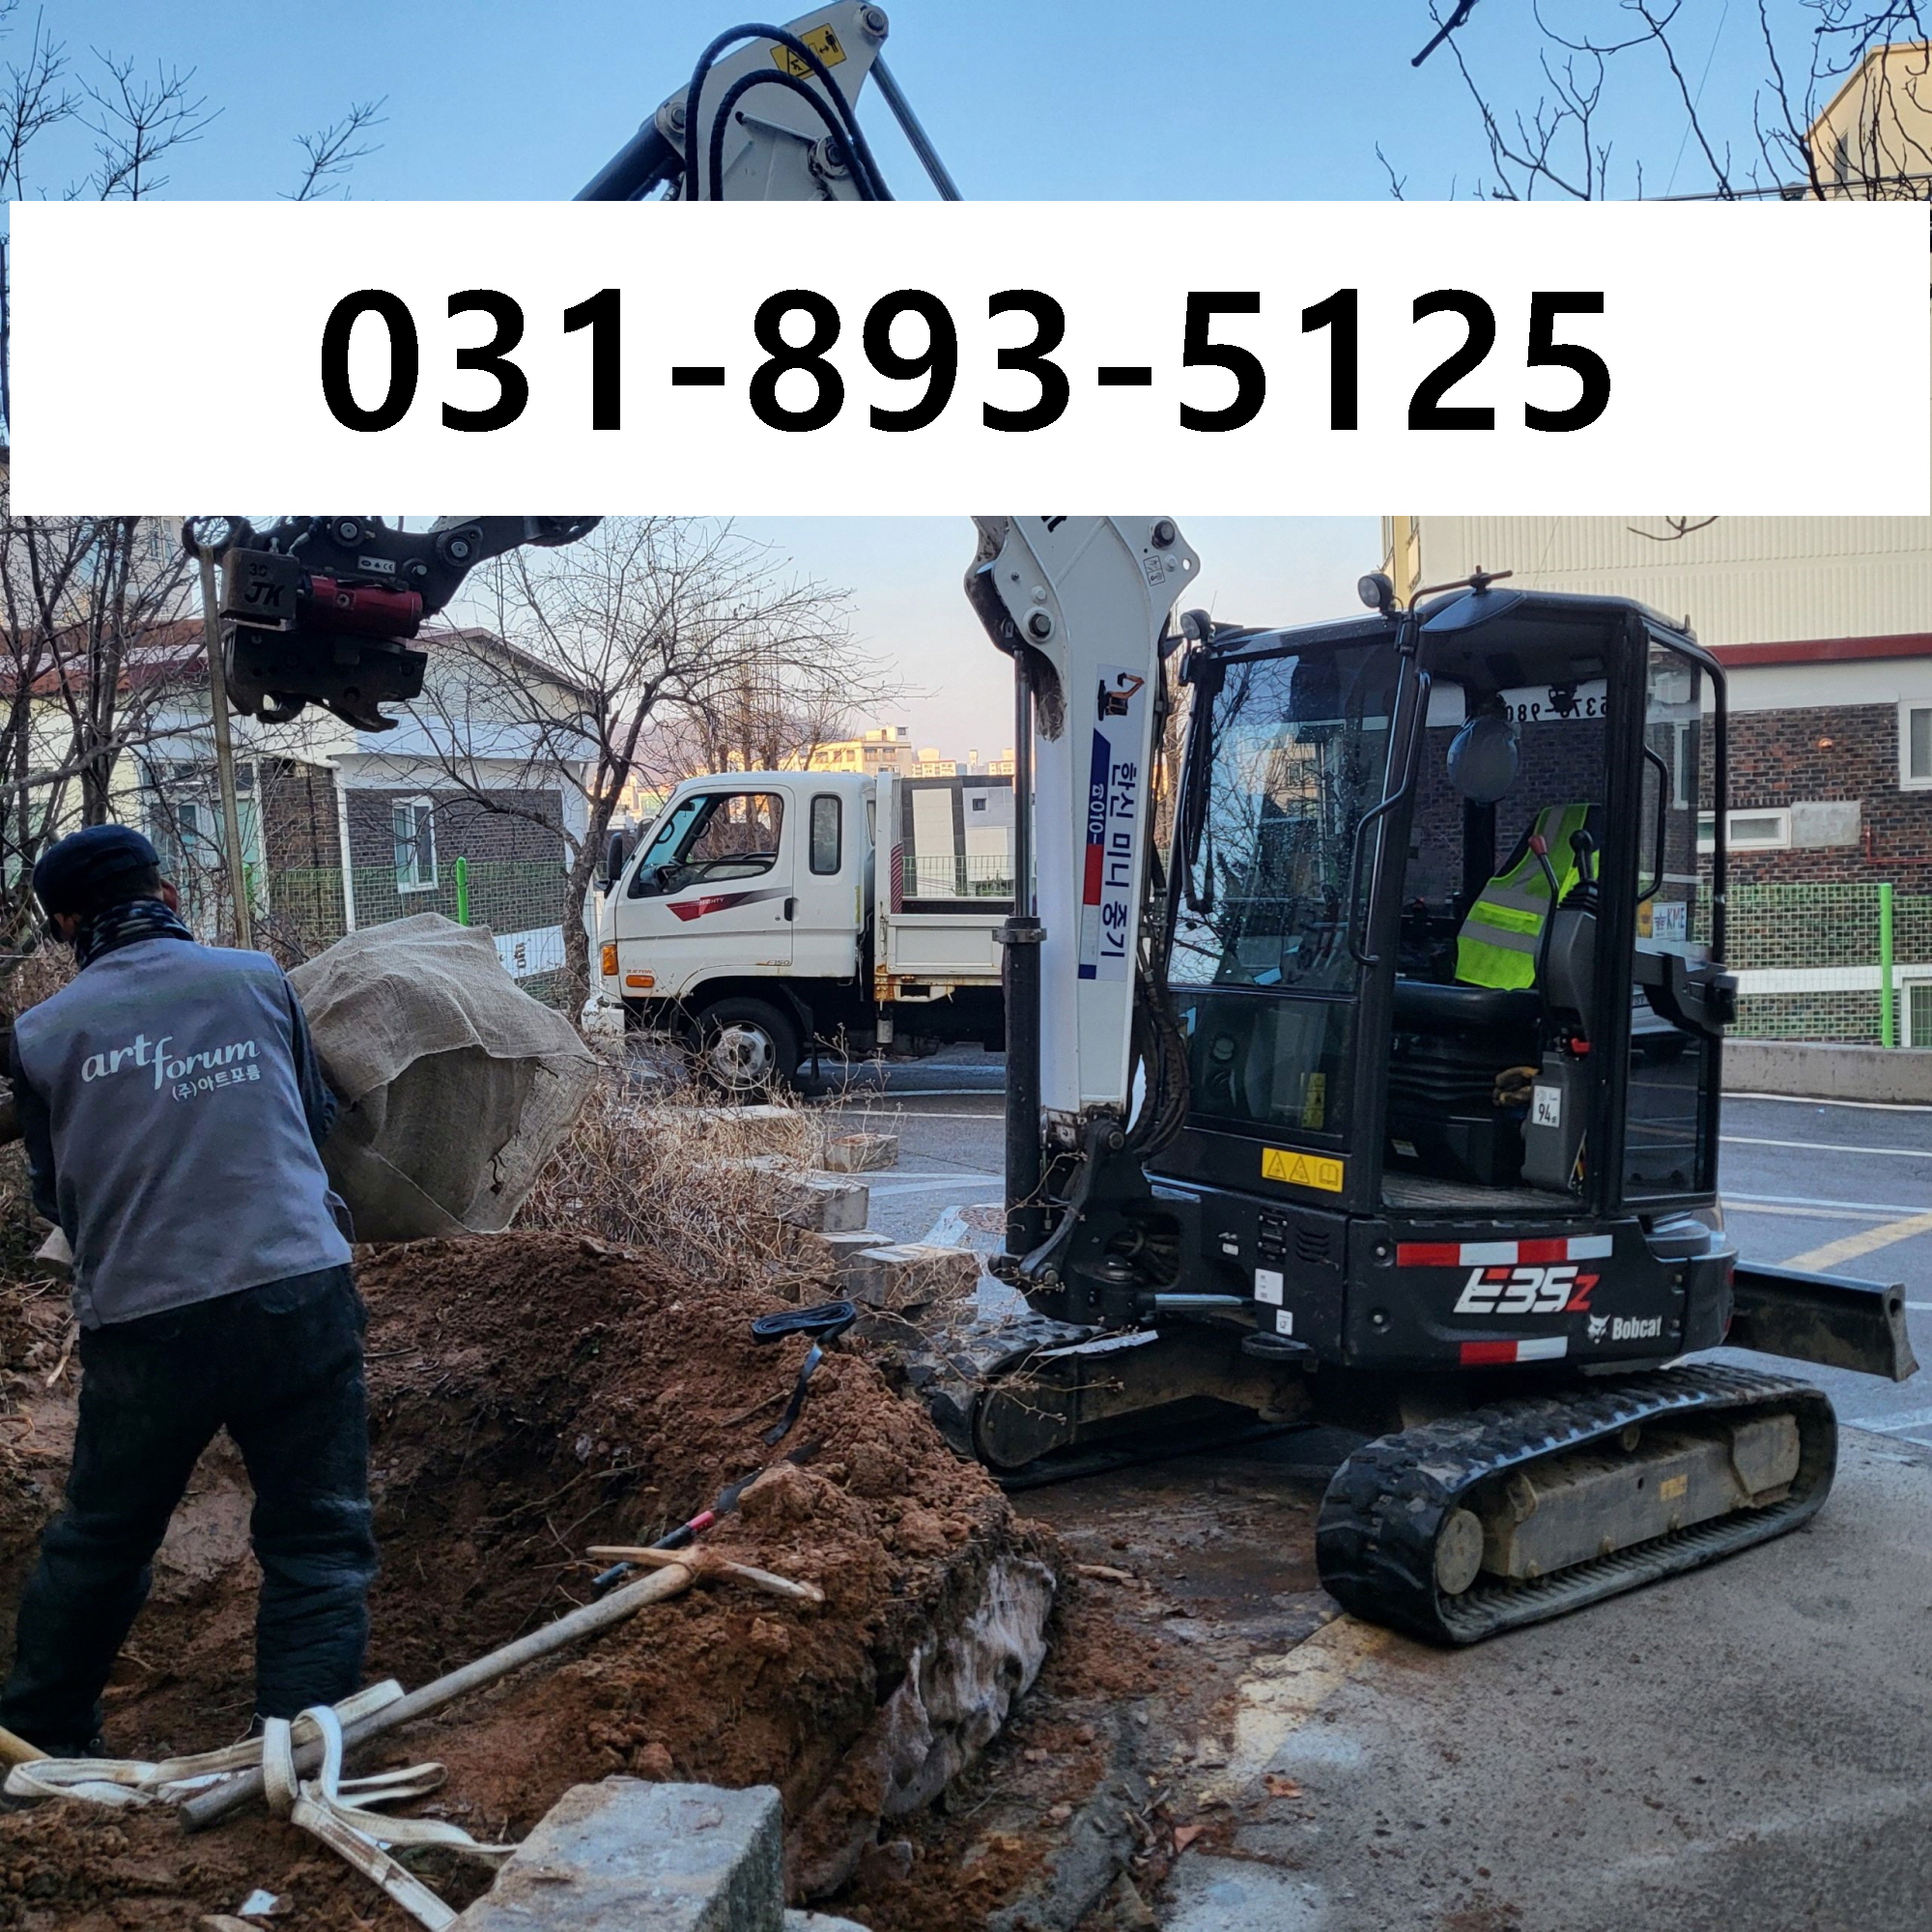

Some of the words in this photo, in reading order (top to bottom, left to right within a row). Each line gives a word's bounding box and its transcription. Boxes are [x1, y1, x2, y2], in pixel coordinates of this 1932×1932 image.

[244, 582, 286, 607] JK
[1110, 762, 1137, 819] 한신
[1105, 833, 1131, 888] 미니
[1100, 900, 1127, 957] 중기
[1538, 1103, 1550, 1122] 94
[1612, 1315, 1663, 1342] Bobcat
